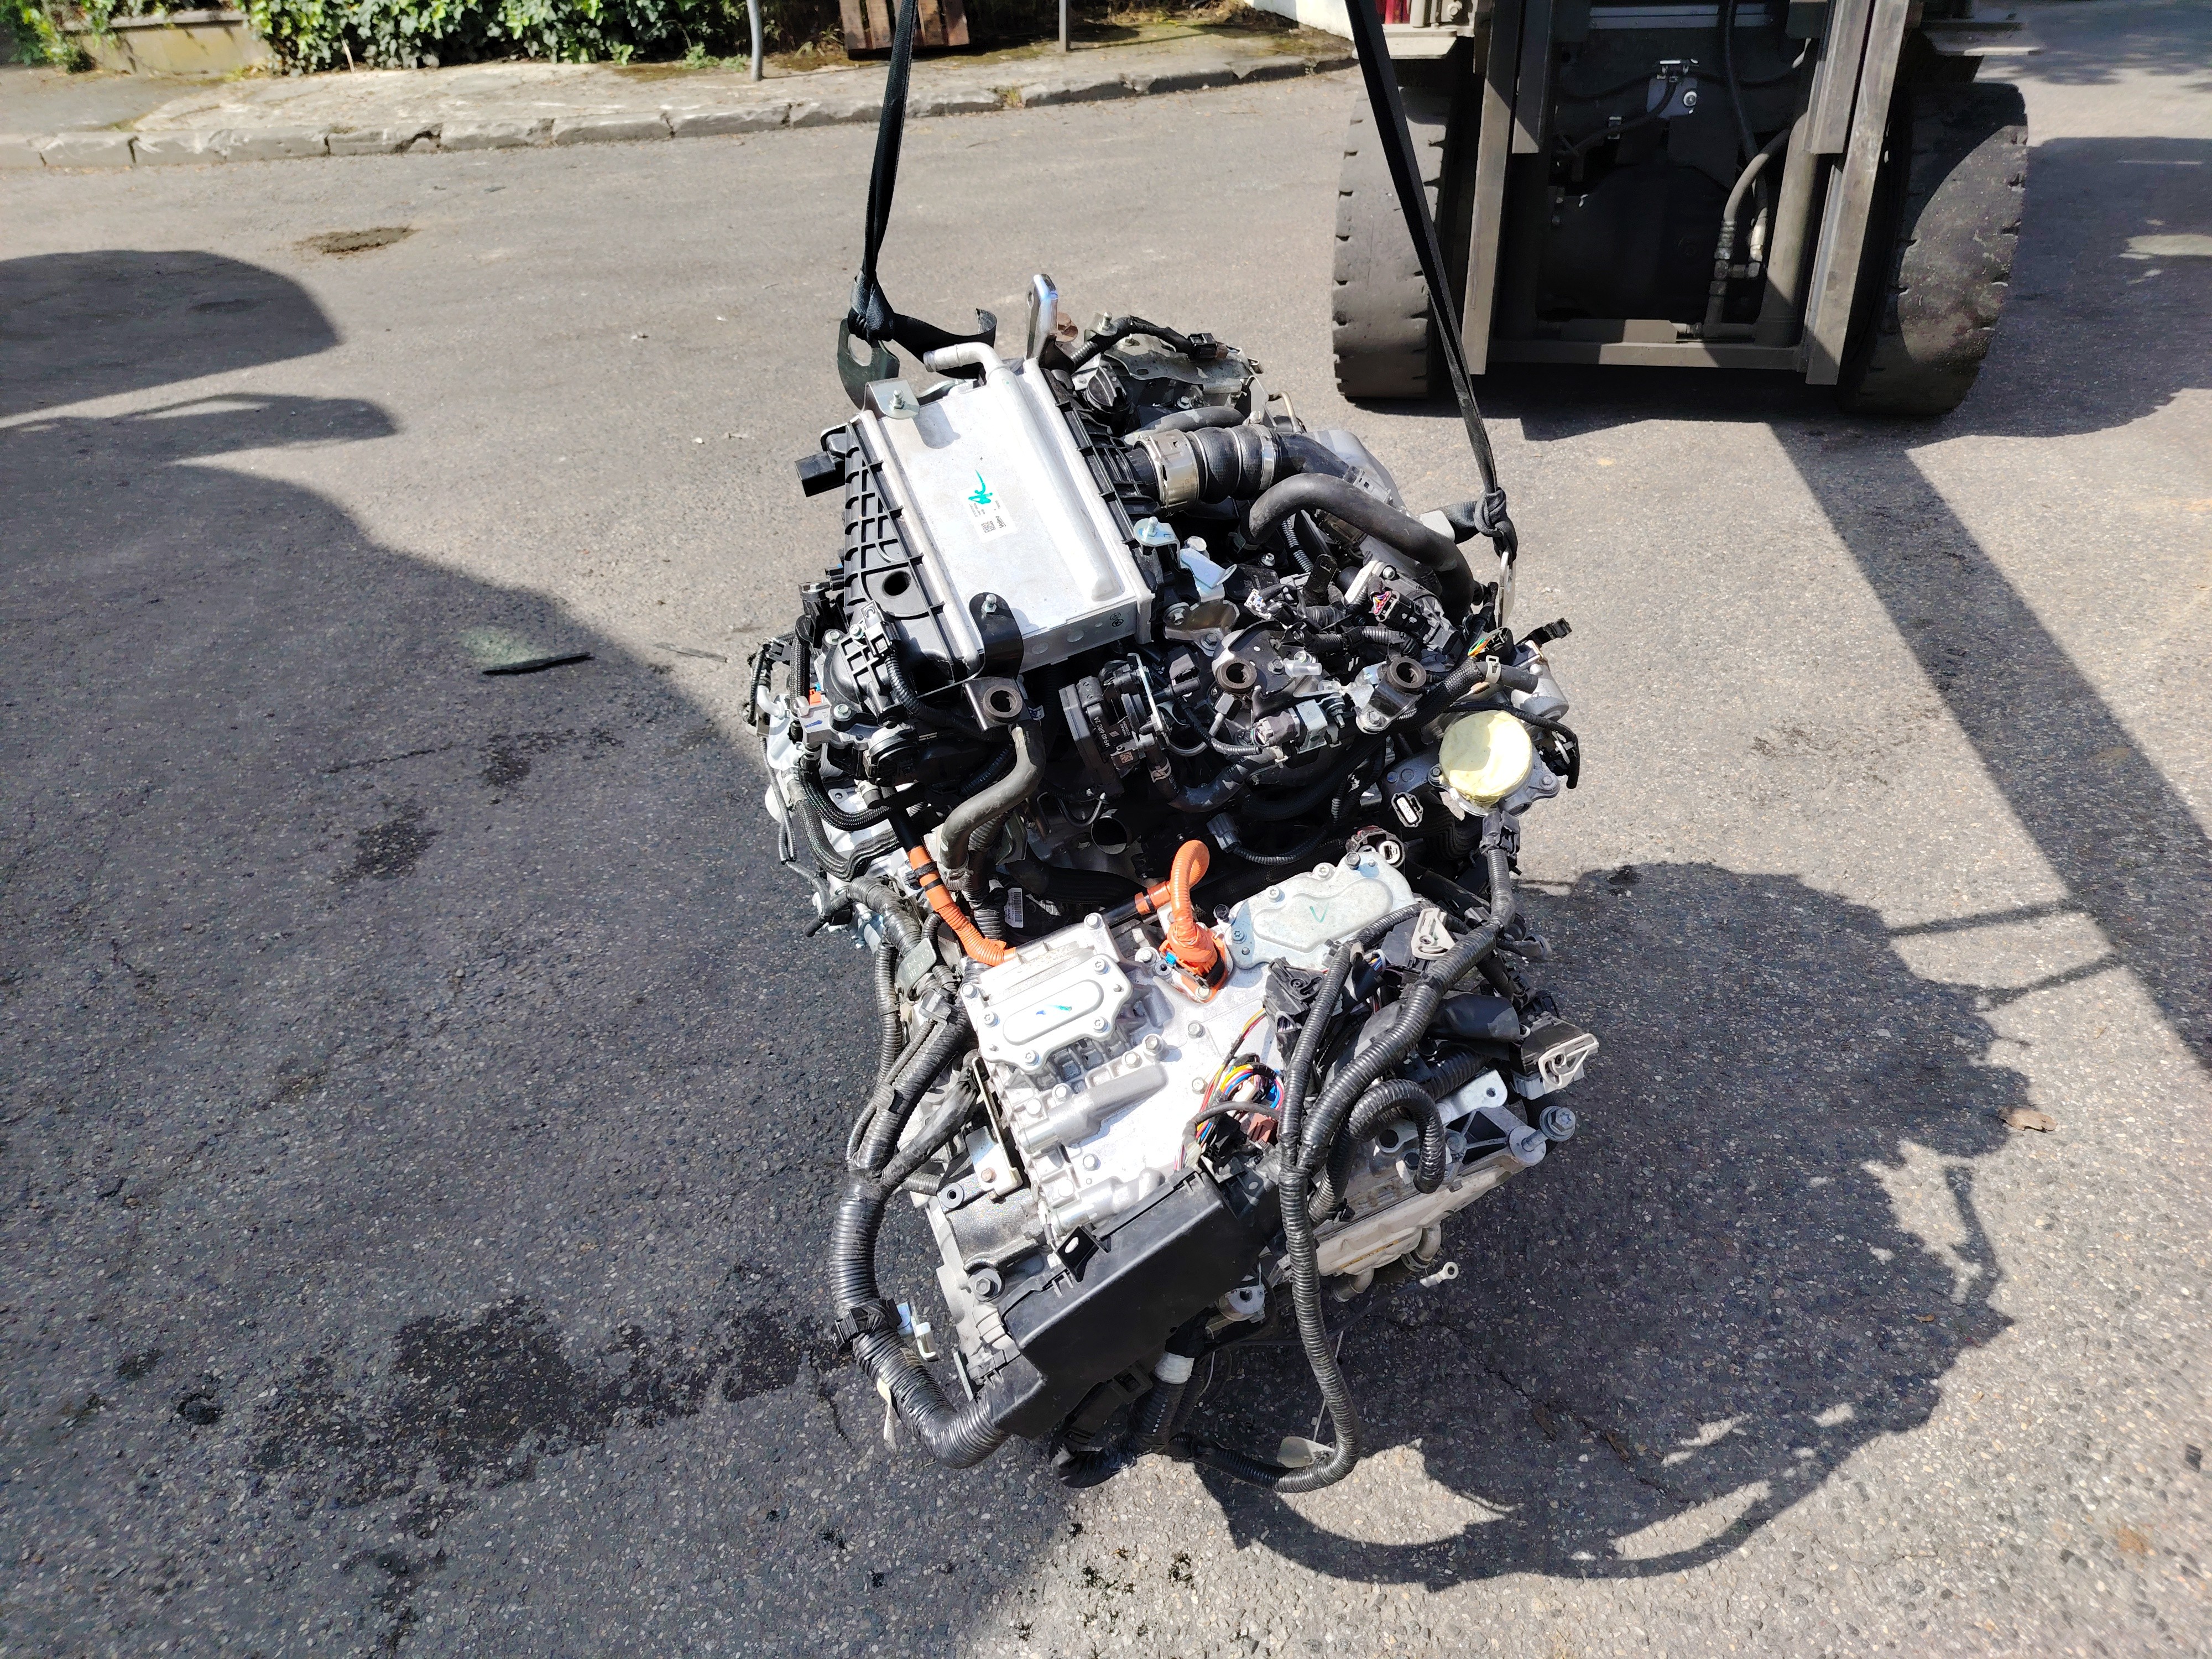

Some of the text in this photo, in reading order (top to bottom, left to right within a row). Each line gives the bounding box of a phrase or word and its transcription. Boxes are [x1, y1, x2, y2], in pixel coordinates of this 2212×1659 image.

[995, 515, 1005, 529] Valeo
[1097, 724, 1105, 733] 6RC
[1101, 733, 1111, 748] 14940
